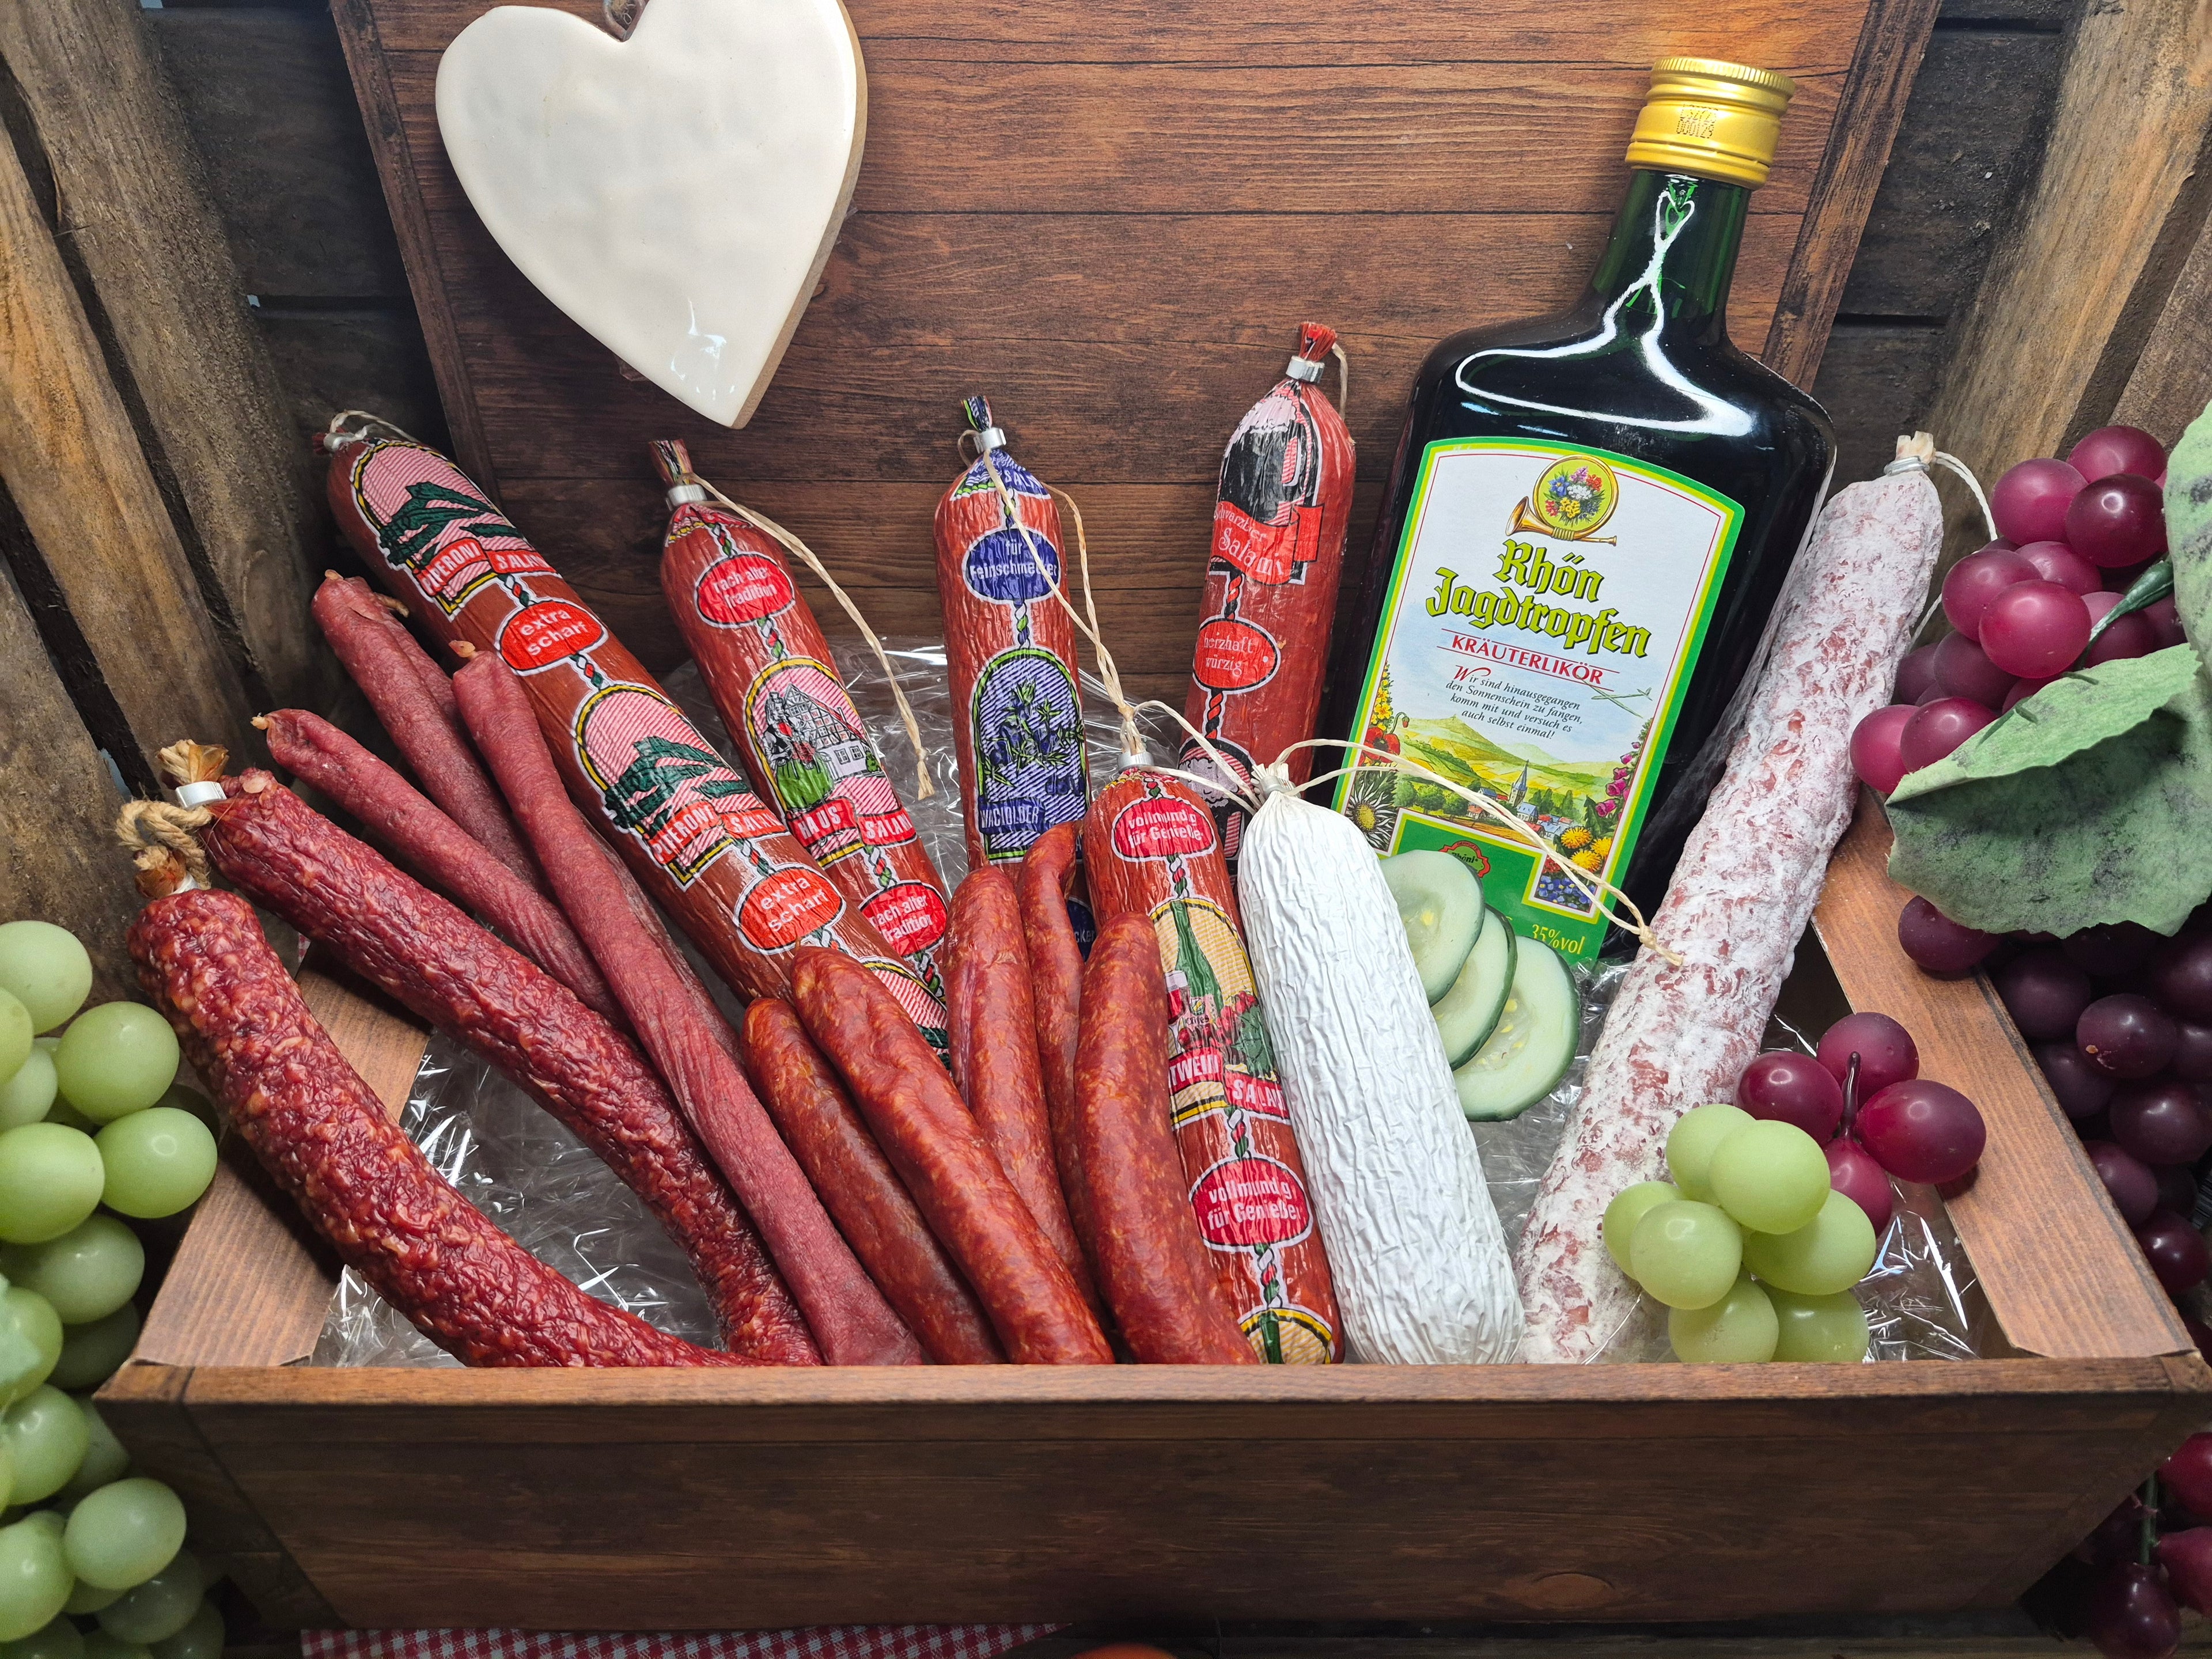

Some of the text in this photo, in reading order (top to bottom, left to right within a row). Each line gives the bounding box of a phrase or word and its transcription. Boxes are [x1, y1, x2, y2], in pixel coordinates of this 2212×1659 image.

[1005, 539, 1022, 556] für
[1218, 527, 1284, 575] Salami
[969, 559, 1058, 581] Feinschmeer
[1493, 539, 1604, 603] Rhön
[520, 609, 572, 636] extra
[1425, 567, 1652, 658] Jagdtropfen
[527, 620, 589, 656] scharf
[1203, 632, 1253, 654] herzhaft
[1452, 634, 1604, 685] KRÄUTERLIKÖR
[1445, 680, 1583, 725] den Sonnenschein zu fangen,
[1453, 664, 1581, 710] Wir sind hinausgegangen
[1450, 693, 1573, 733] komm mit und versuch es
[1461, 709, 1555, 740] auch selbst einmal!
[797, 805, 841, 840] HAUS
[1127, 810, 1197, 830] vollmundg
[1127, 824, 1204, 849] für Genieße
[760, 877, 812, 910] extra
[902, 895, 929, 914] alter
[768, 888, 829, 932] scharf
[1169, 1054, 1219, 1086] TWEIN
[1208, 1176, 1293, 1204] vollmundg
[1207, 1206, 1230, 1230] für
